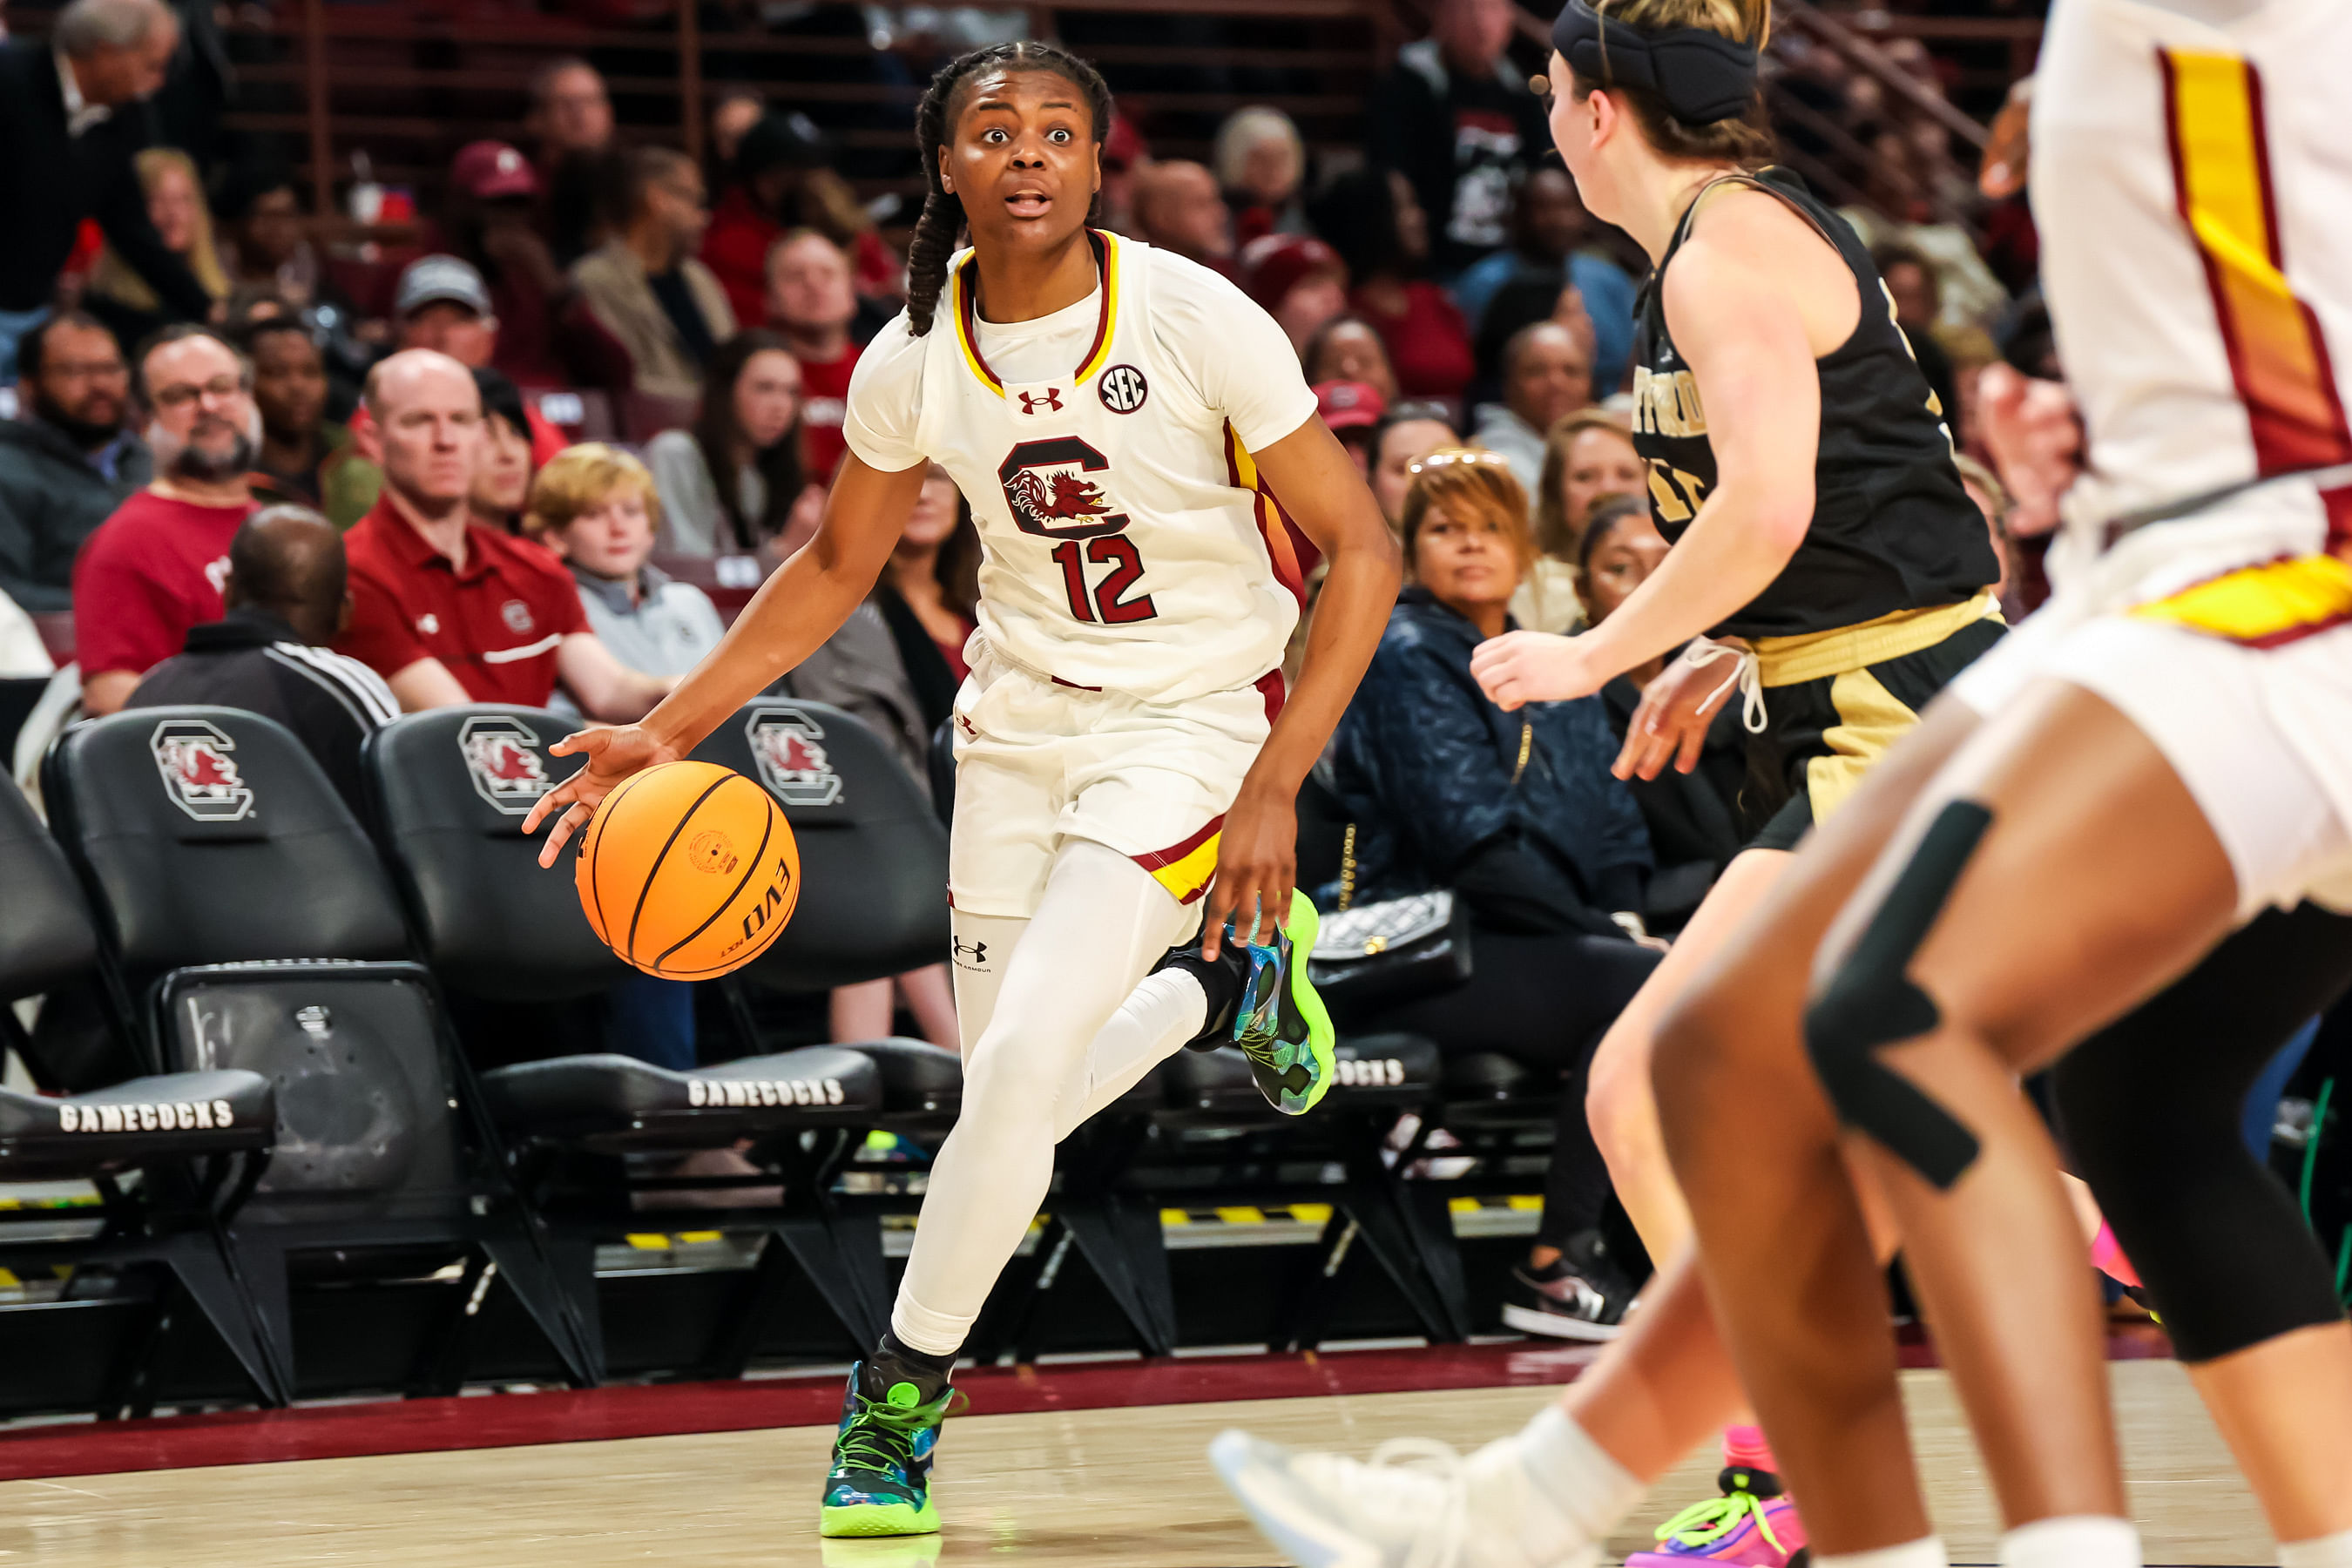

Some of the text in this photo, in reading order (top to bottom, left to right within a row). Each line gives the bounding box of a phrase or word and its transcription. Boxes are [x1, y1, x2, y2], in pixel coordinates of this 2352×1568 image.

[1101, 367, 1145, 411] SEC
[1051, 534, 1159, 625] 12
[742, 856, 791, 941] EVO
[688, 1078, 845, 1107] GAMECOCKS
[59, 1099, 233, 1132] GAMECOCKS
